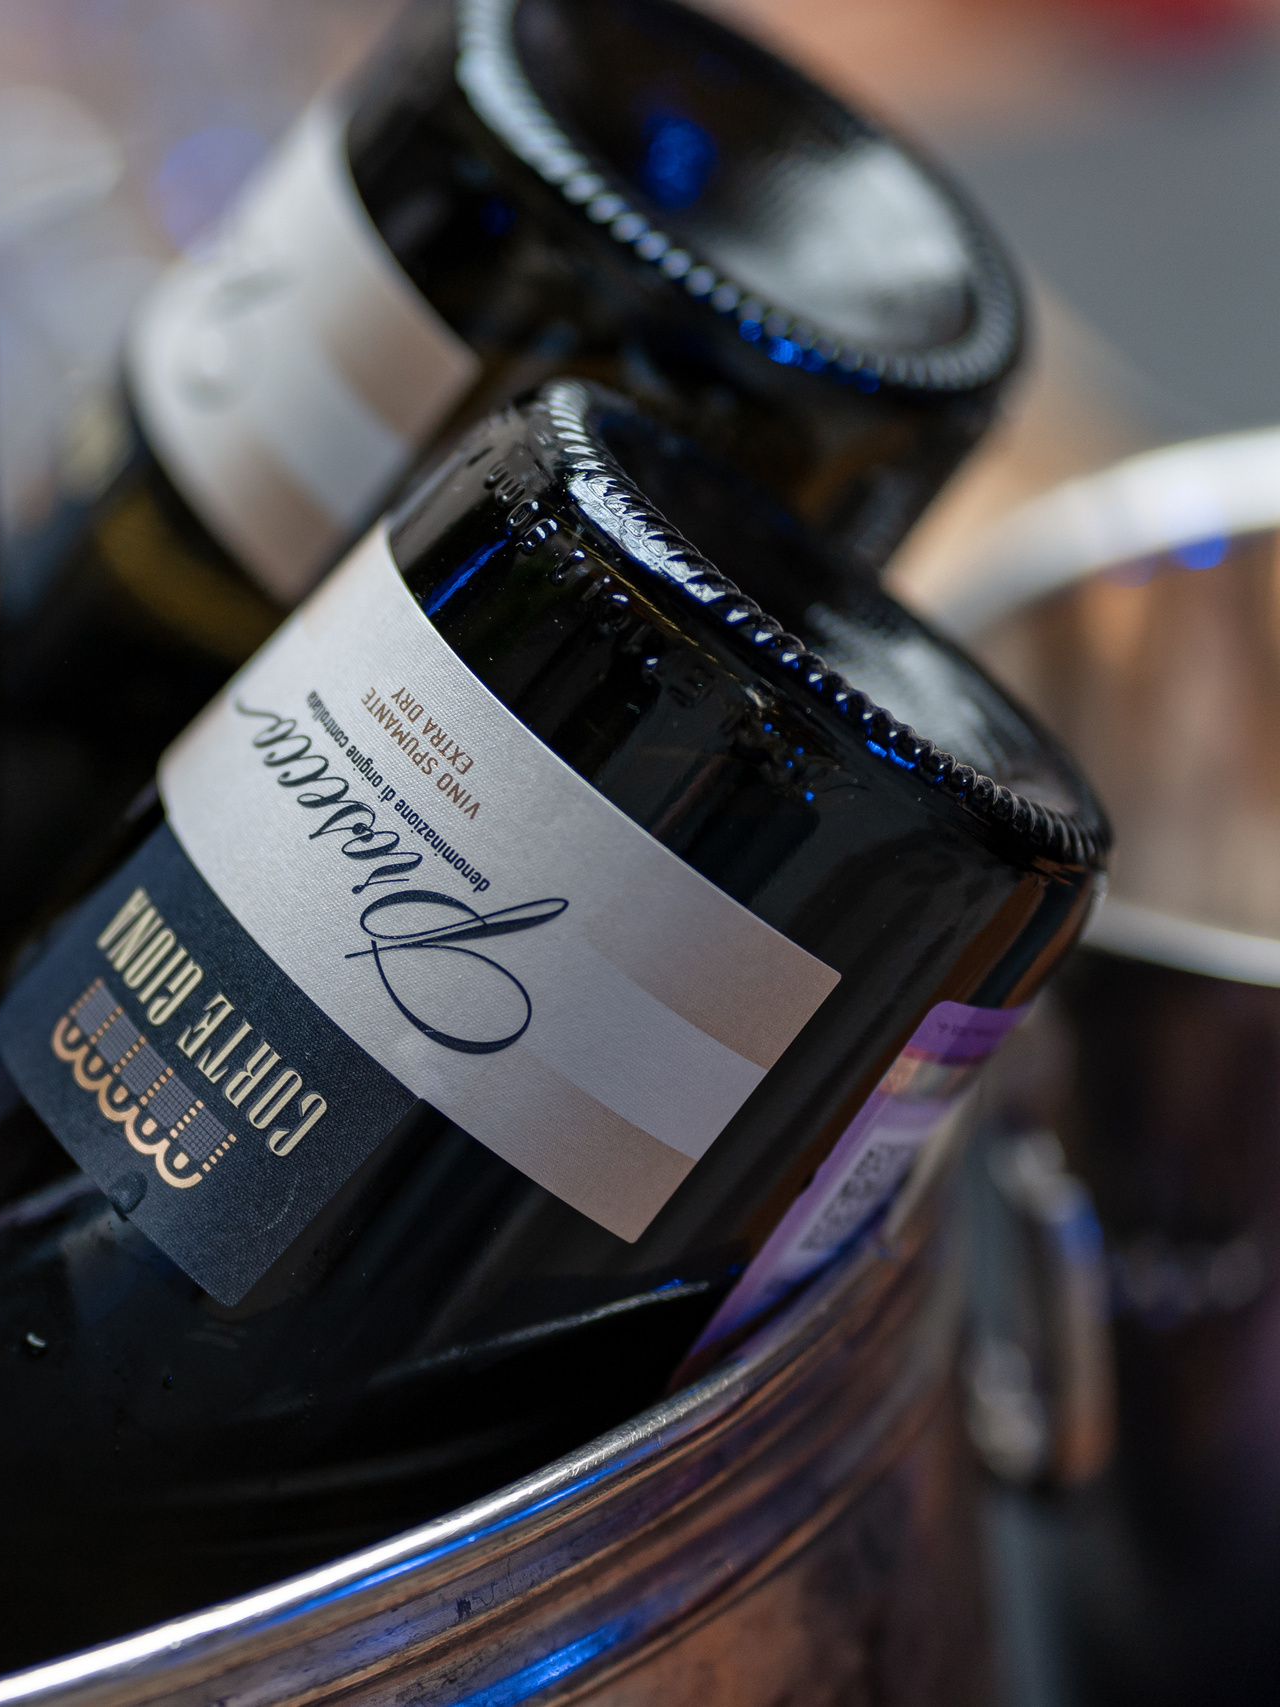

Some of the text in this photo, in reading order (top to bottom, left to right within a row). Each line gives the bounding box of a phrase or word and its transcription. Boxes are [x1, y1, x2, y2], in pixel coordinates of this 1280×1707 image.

[306, 690, 491, 893] denominazione di origine controllata
[360, 686, 481, 820] VINO SPUMANTE
[391, 686, 474, 775] EXTRA DRY
[235, 699, 569, 1055] Prosecco
[96, 886, 327, 1157] CORTE GIONA
